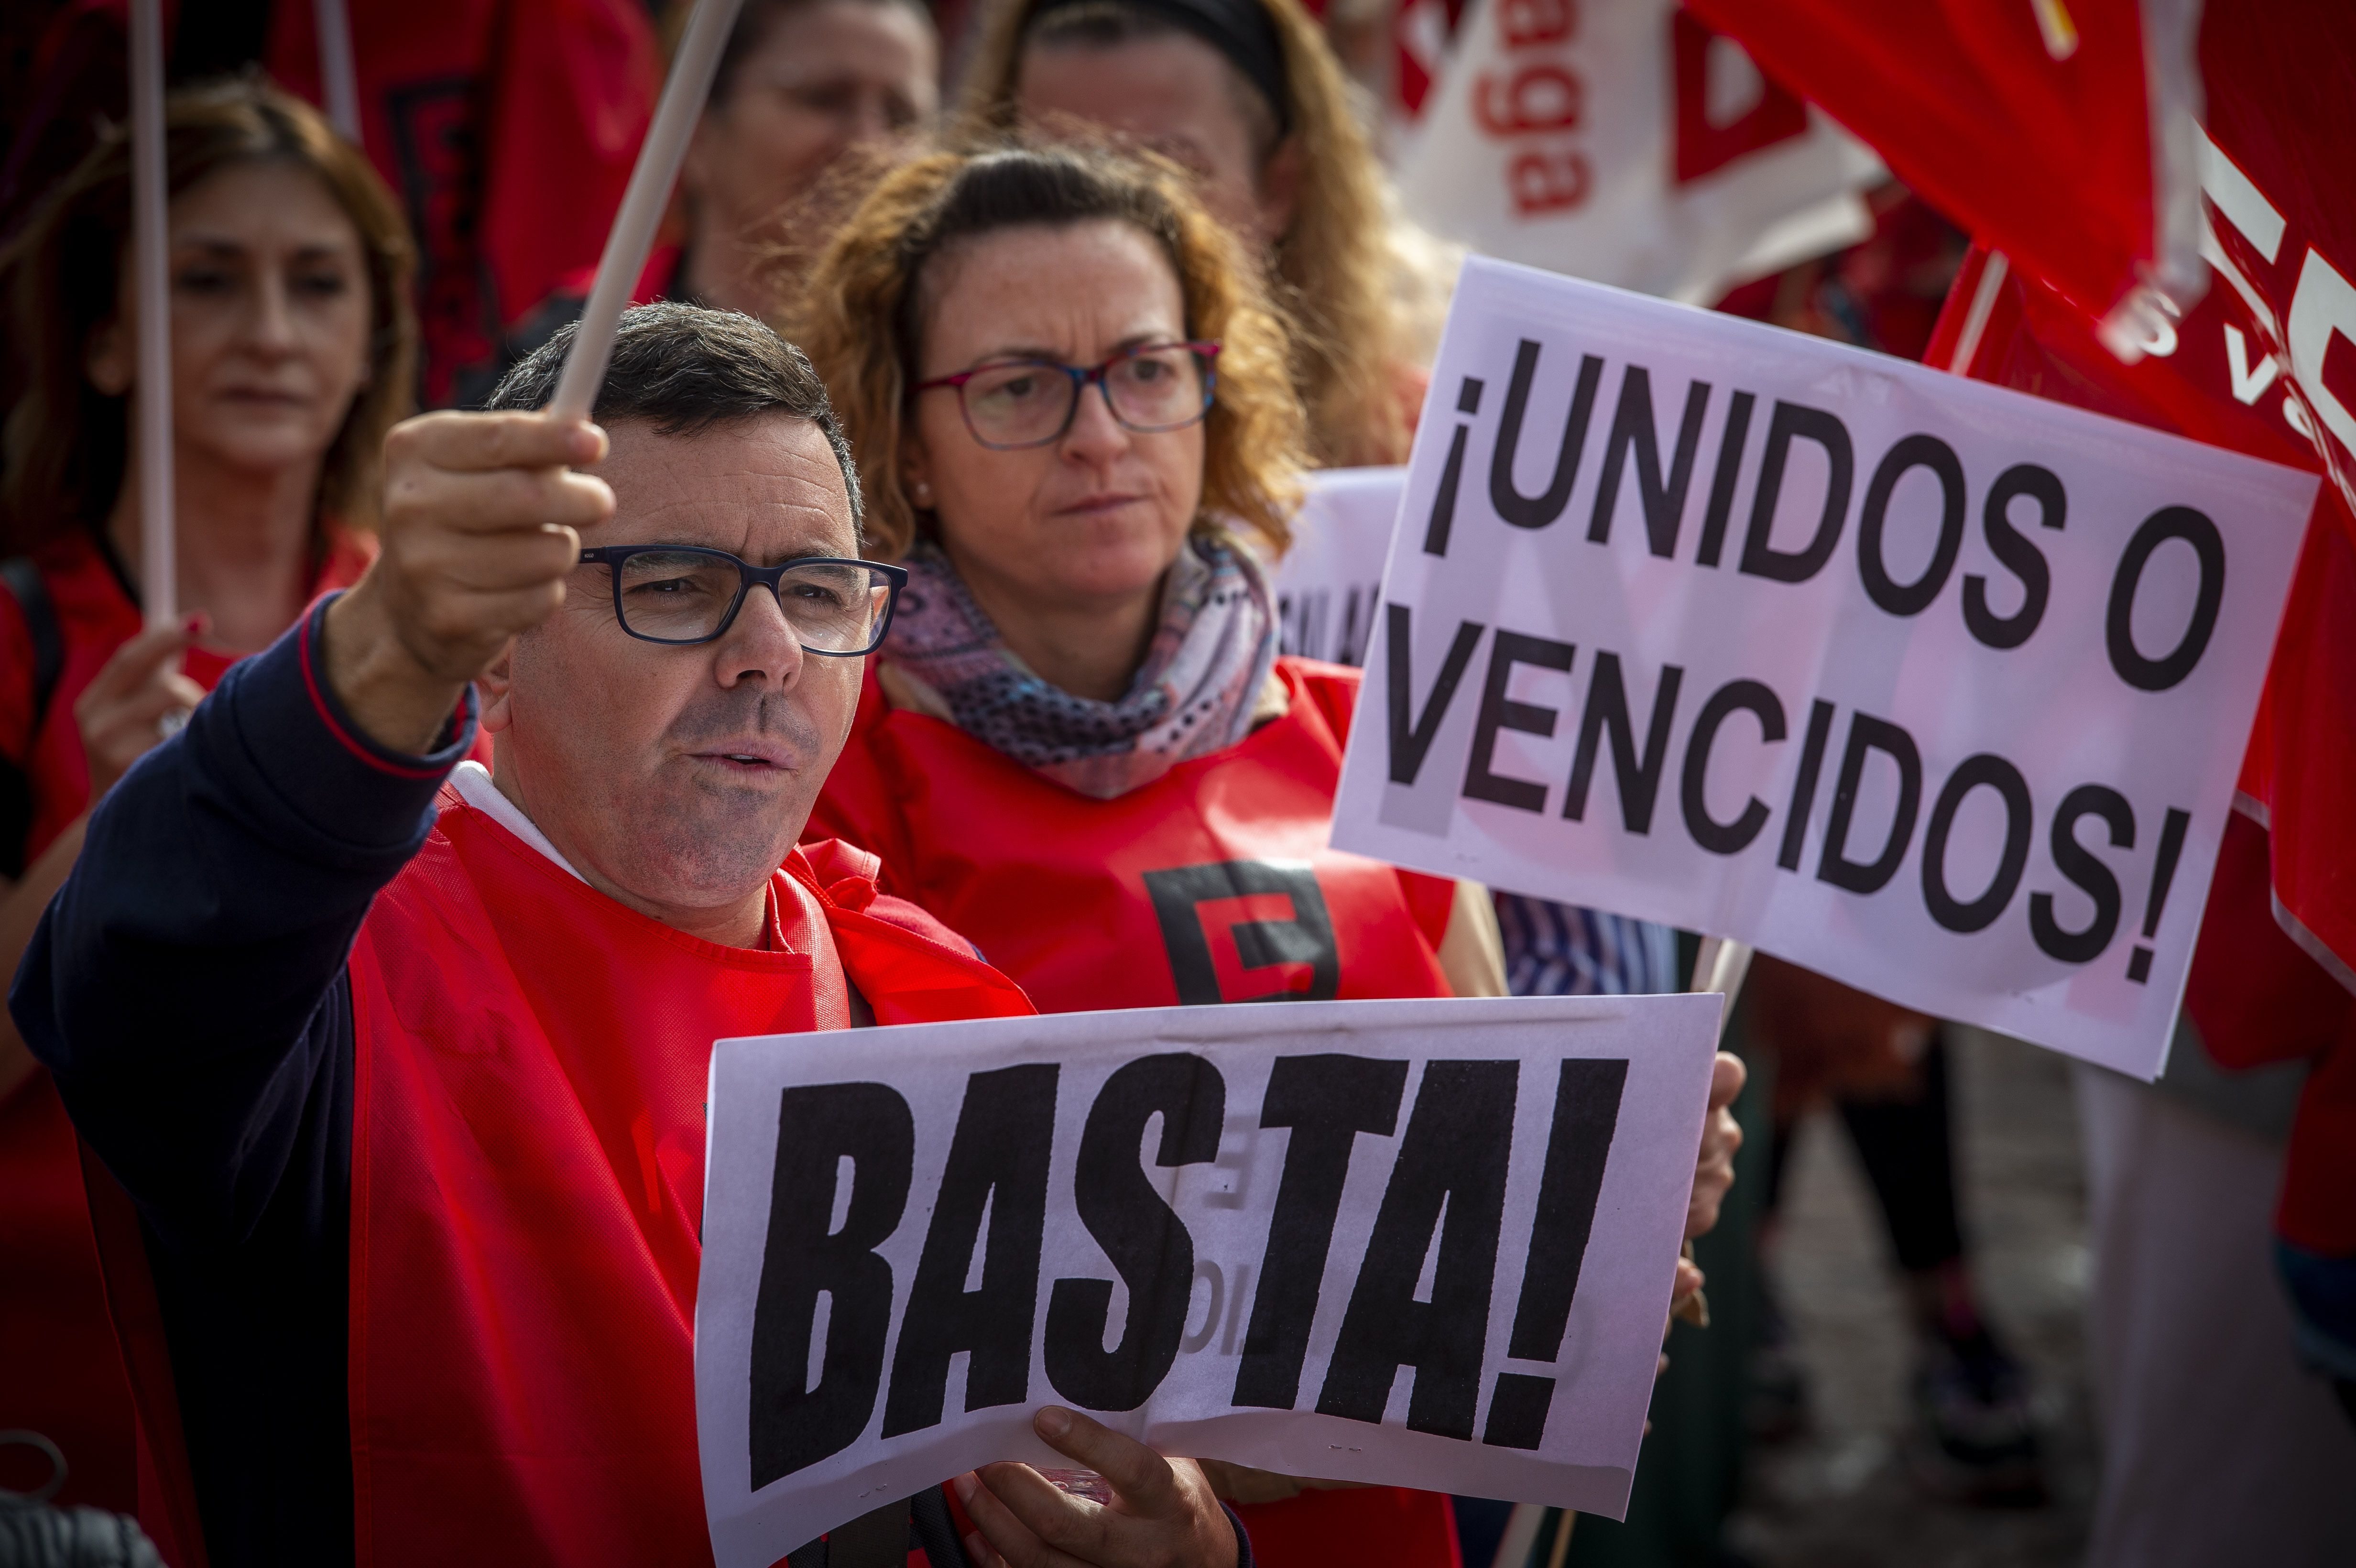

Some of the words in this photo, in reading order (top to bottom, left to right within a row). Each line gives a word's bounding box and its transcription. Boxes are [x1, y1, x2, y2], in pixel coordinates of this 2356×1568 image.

[1423, 338, 2068, 650] ¡UNIDOS
[2105, 504, 2227, 693] O
[1386, 603, 2192, 985] VENCIDOS!
[750, 1052, 1628, 1493] BASTA!
